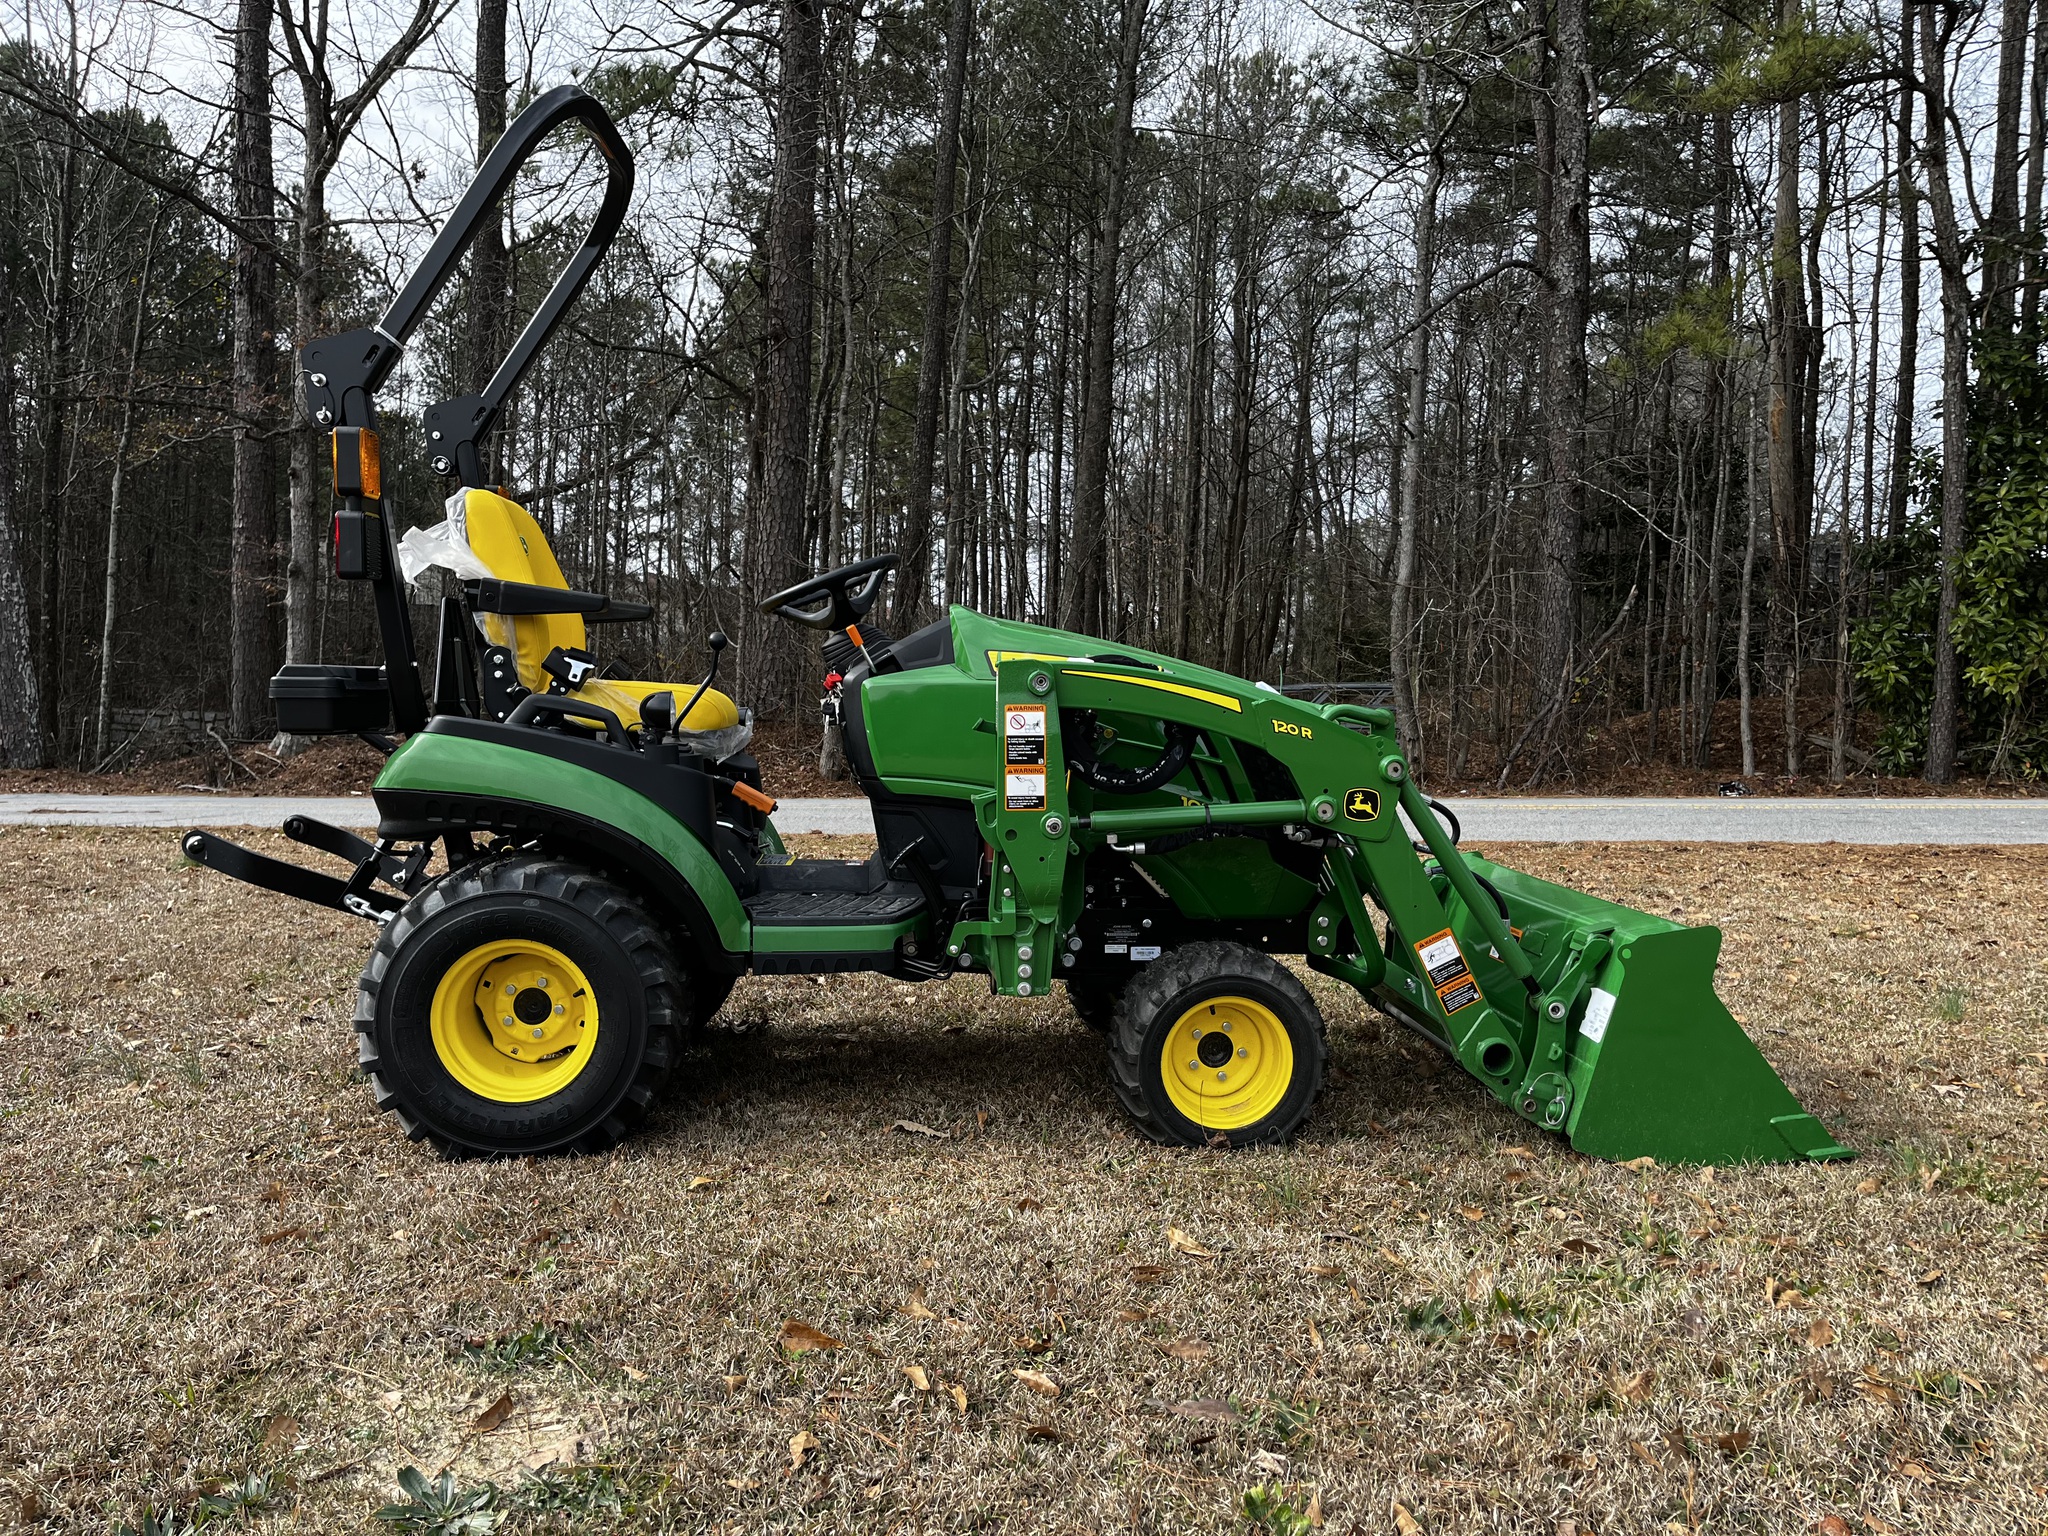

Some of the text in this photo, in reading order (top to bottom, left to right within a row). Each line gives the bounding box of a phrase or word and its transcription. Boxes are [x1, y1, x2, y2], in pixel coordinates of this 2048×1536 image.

[1271, 718, 1314, 740] 120 R
[1424, 931, 1448, 946] WARNING
[1446, 977, 1470, 992] WARNING
[429, 1092, 573, 1136] CARLISLE
